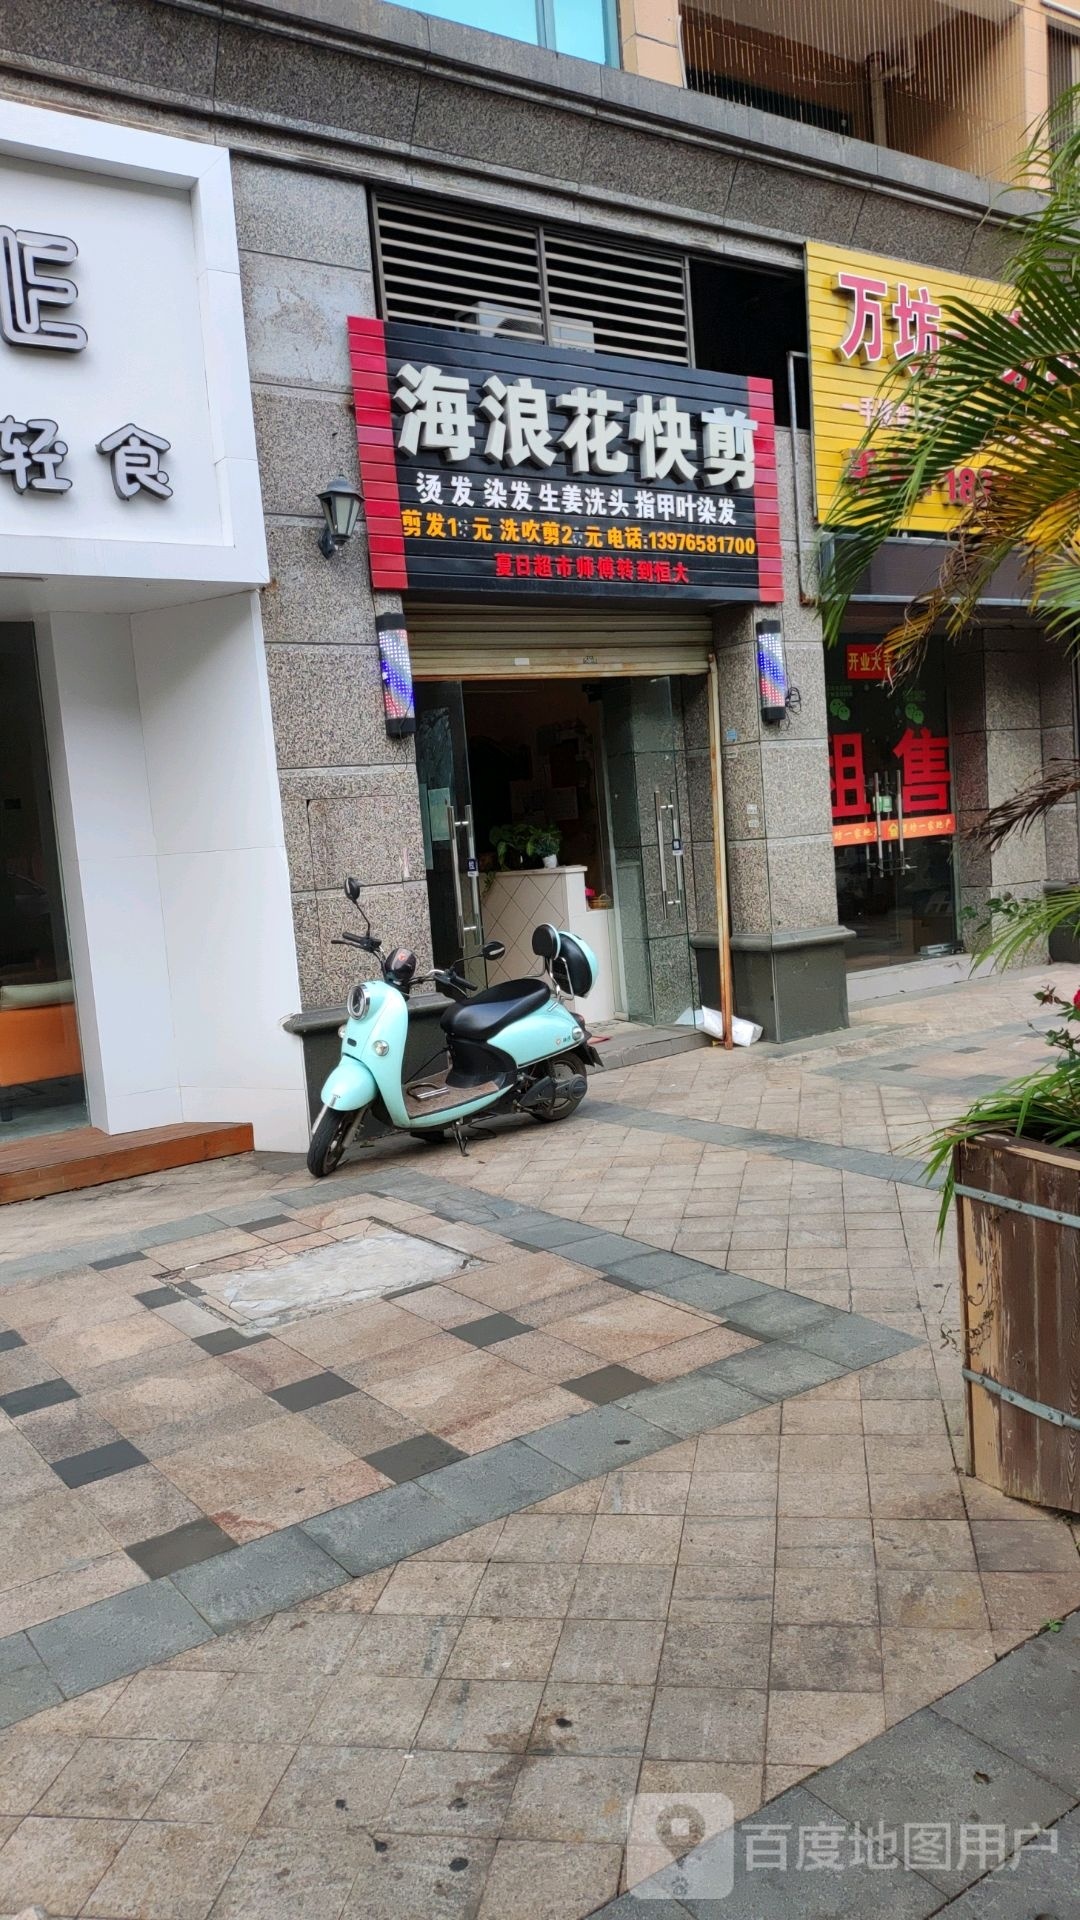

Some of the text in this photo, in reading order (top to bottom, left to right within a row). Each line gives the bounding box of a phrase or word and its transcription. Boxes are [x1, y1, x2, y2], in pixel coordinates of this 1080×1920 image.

[392, 362, 758, 492] 海浪花快剪
[0, 415, 174, 501] 轻食
[416, 471, 737, 526] 烫发 染发 生姜洗头 指甲叶染发
[494, 552, 689, 583] 夏日超市师傅转到恒大
[607, 526, 756, 555] 电话:13976581700
